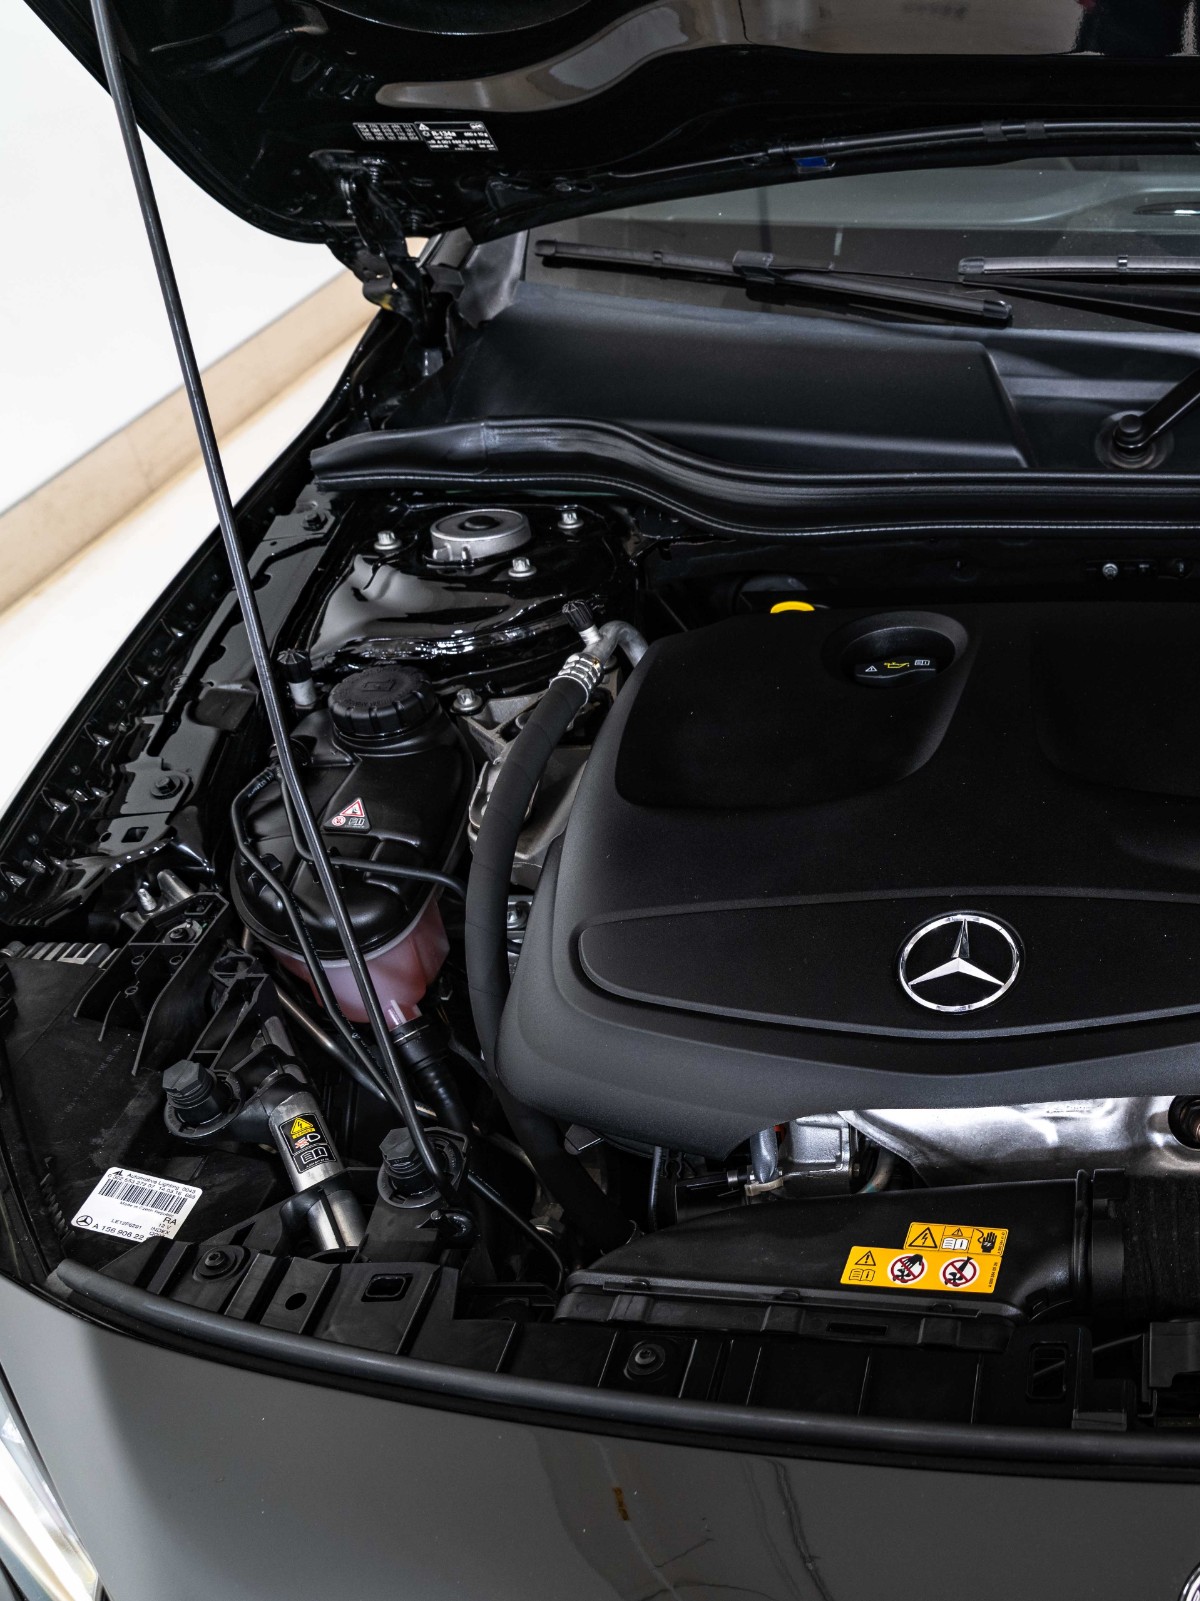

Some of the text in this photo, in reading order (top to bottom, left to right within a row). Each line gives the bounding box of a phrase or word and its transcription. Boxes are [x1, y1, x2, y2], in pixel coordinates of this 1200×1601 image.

[128, 1173, 158, 1184] Automotive
[158, 1181, 179, 1190] Lighting
[163, 1217, 177, 1225] RA
[101, 1225, 116, 1234] 156
[117, 1230, 132, 1238] 906
